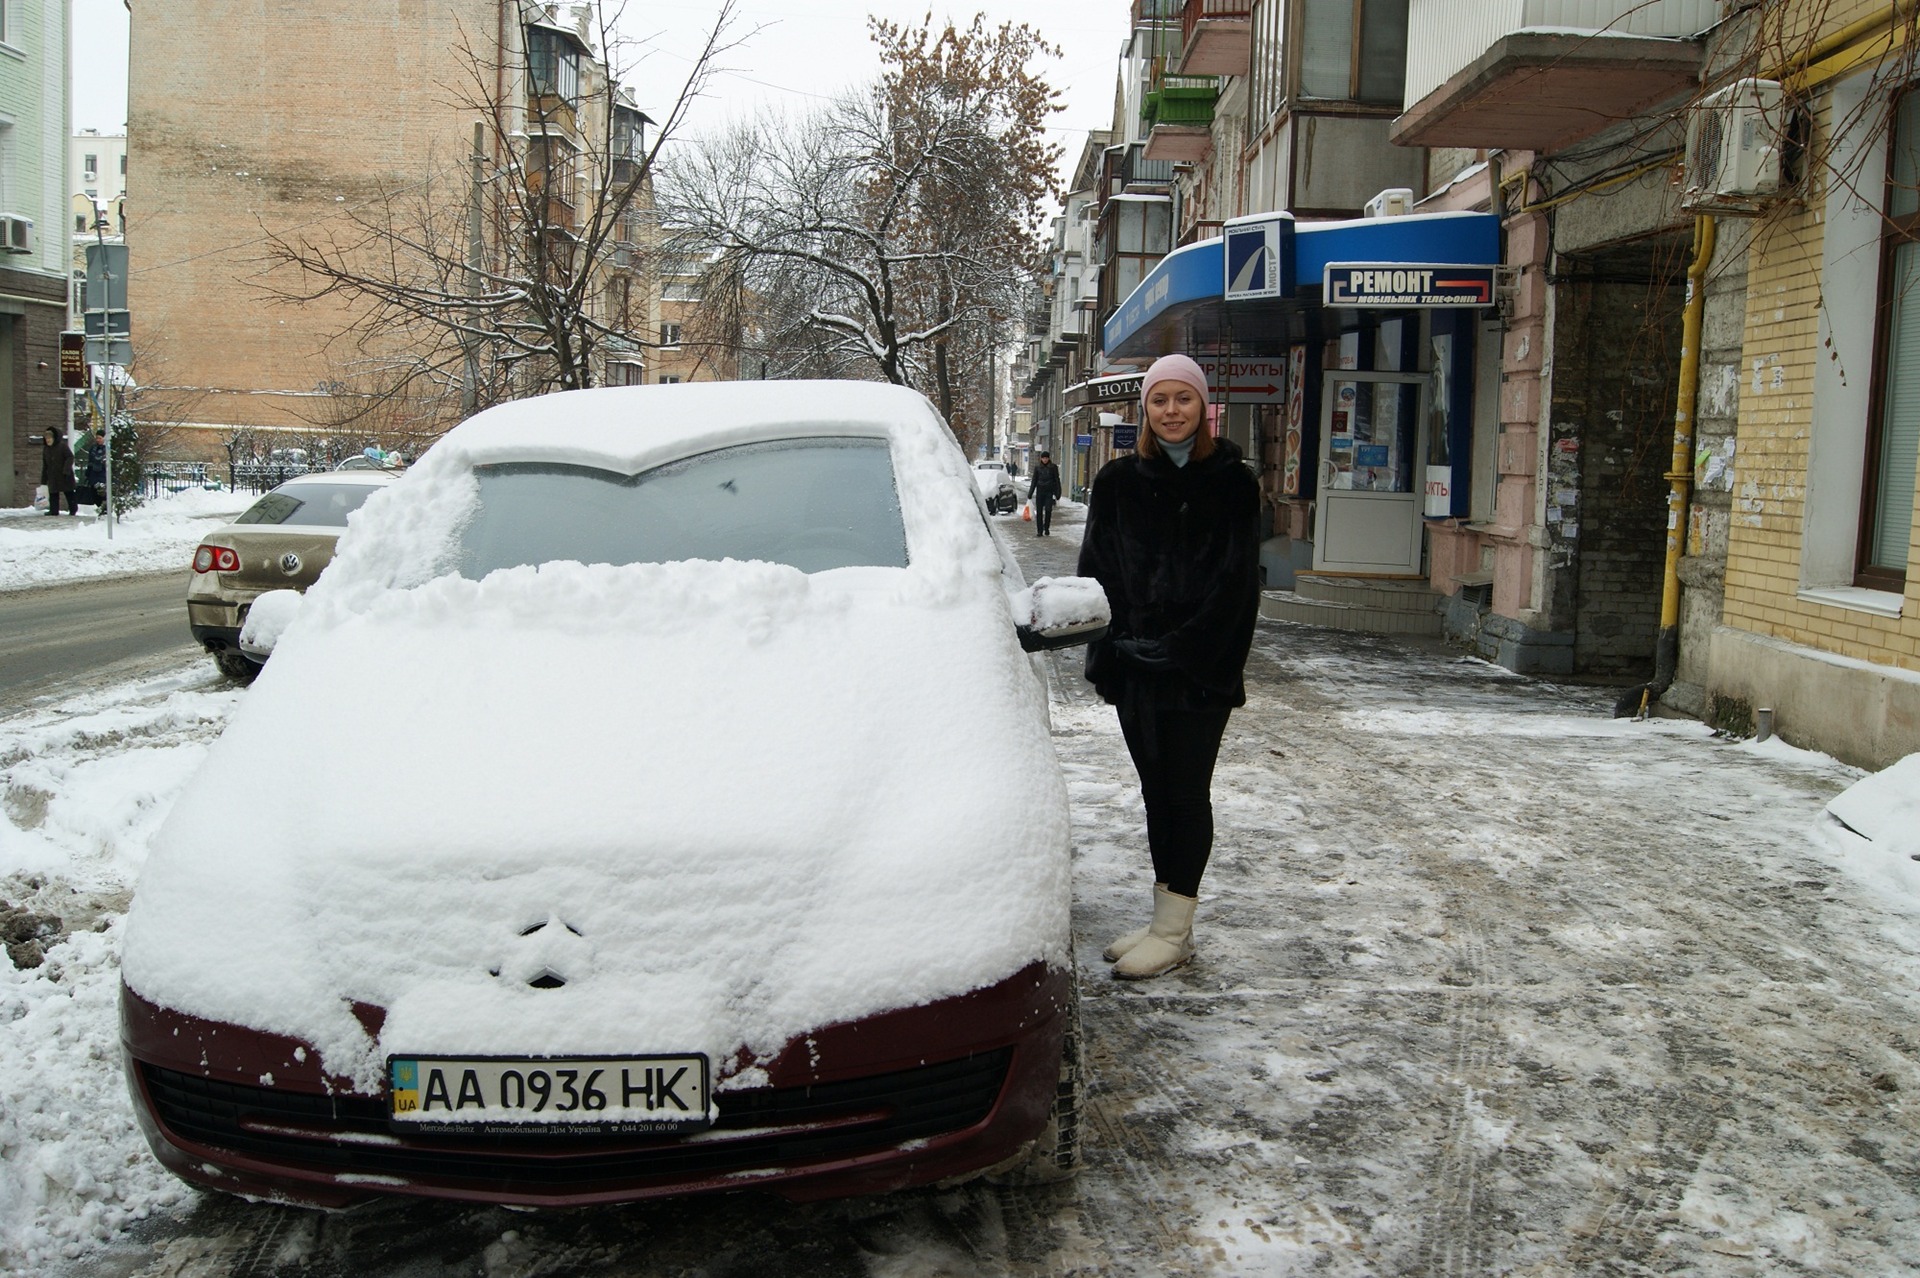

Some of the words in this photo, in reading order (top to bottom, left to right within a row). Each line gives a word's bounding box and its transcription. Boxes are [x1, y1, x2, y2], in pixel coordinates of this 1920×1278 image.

[1268, 261, 1277, 289] МОСТ
[1350, 271, 1434, 293] РЕМОНТ
[1357, 295, 1418, 304] МОБІЛЬНИХ
[1420, 295, 1478, 304] ТЕЛЕФОНІВ
[1097, 381, 1142, 397] НОТА
[423, 1068, 486, 1112] AA
[500, 1068, 608, 1113] 0936
[621, 1066, 690, 1111] HK
[398, 1099, 417, 1111] UA
[419, 1123, 475, 1133] Mercedes-Benz
[484, 1125, 548, 1134] Автомобільний
[549, 1125, 566, 1134] Дім
[568, 1125, 602, 1135] Україна
[621, 1124, 637, 1132] 044
[638, 1123, 653, 1132] 201
[655, 1123, 666, 1131] 60
[667, 1122, 678, 1131] 00
